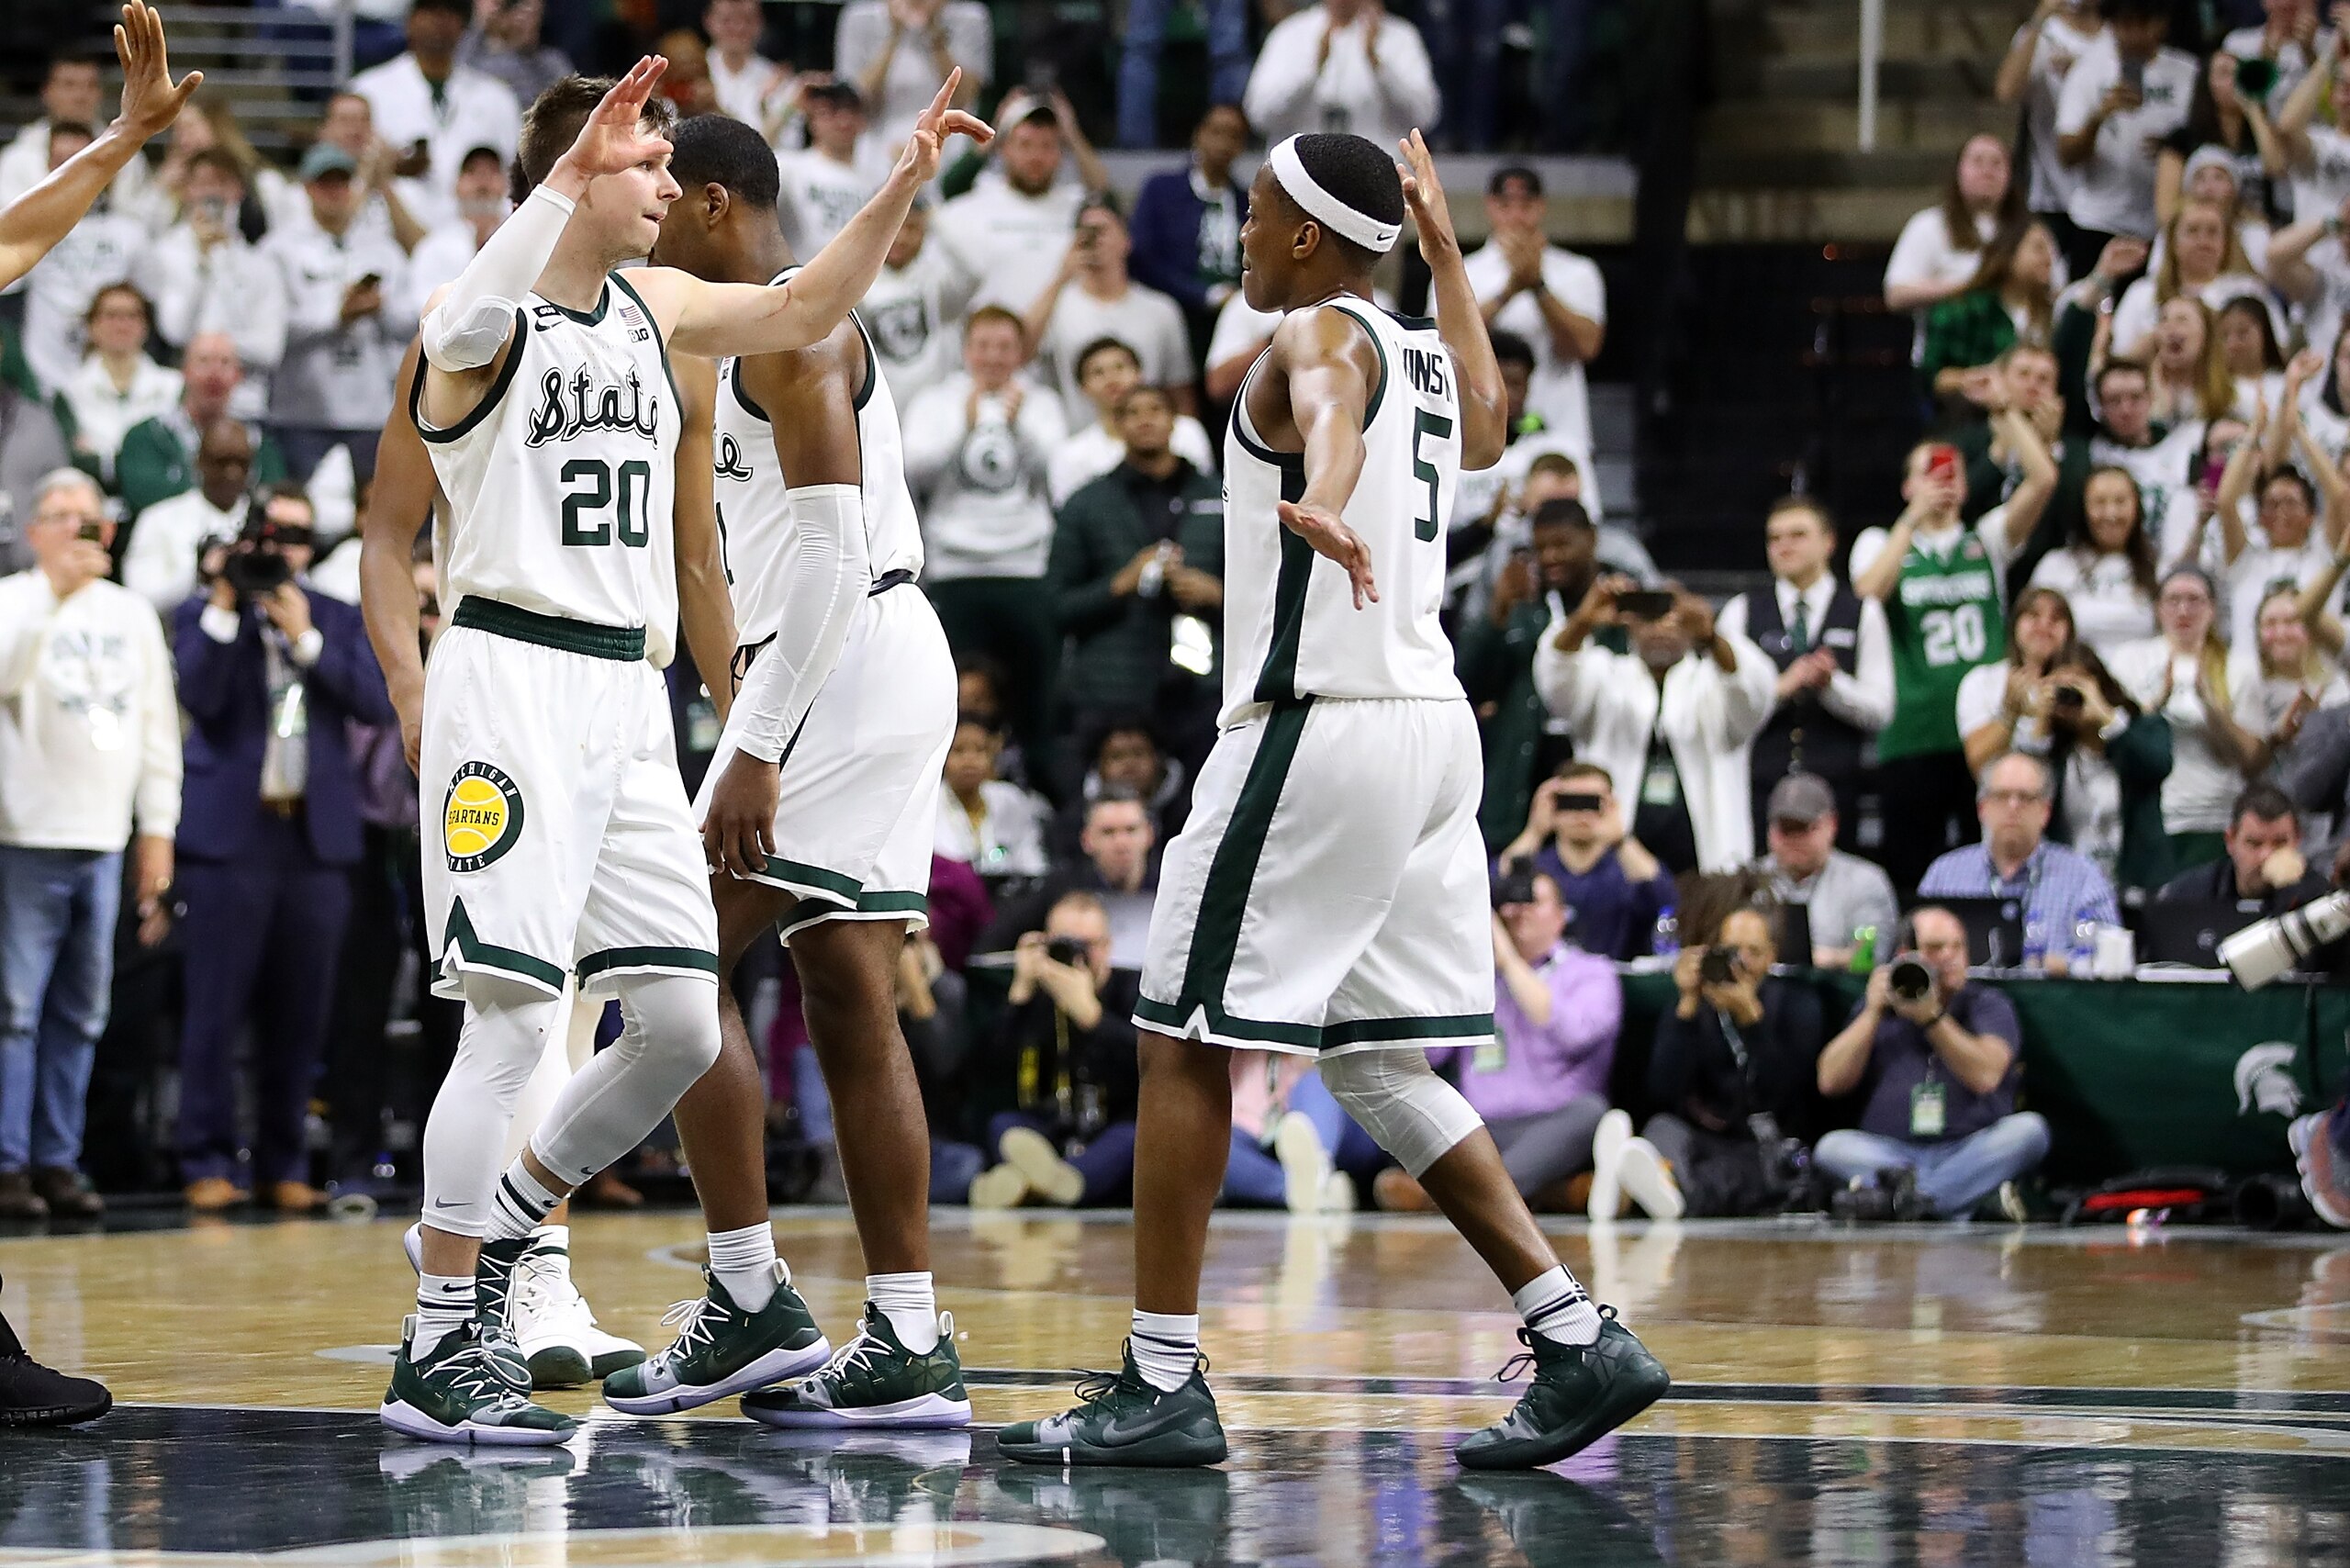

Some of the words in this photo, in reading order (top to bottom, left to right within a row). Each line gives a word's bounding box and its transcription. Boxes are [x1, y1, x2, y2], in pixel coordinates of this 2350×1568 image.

[524, 362, 658, 450] State
[560, 459, 651, 548] 20
[1412, 406, 1453, 543] 5
[1919, 602, 1986, 667] 20
[448, 762, 518, 798] MICHIGAN
